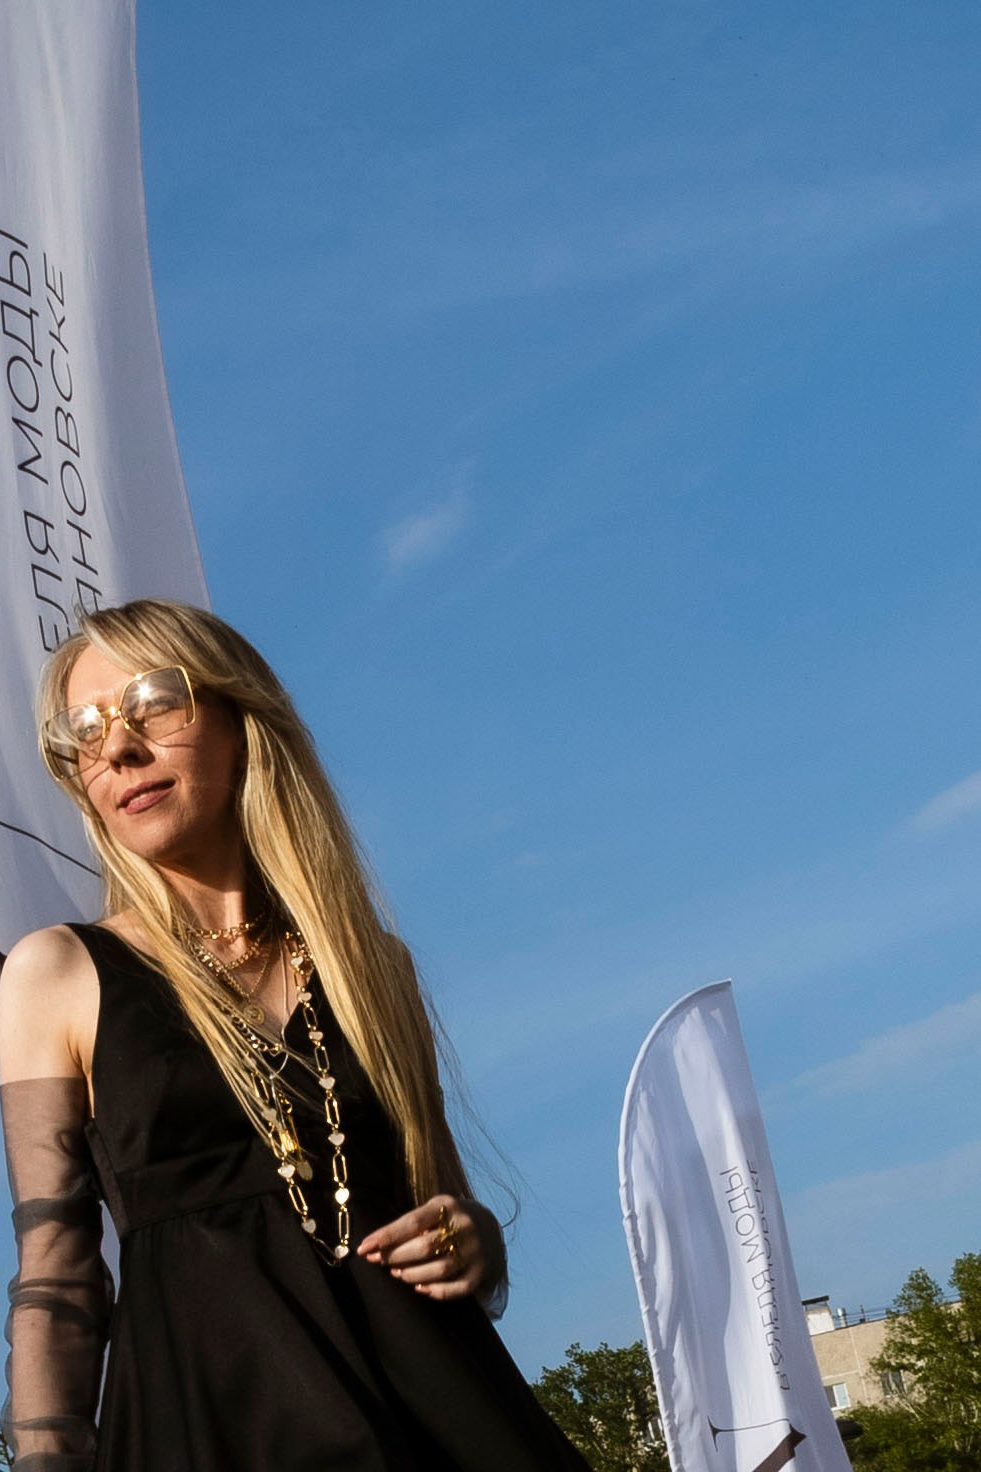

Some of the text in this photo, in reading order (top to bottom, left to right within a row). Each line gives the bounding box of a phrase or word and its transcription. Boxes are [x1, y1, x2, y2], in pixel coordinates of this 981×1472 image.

[42, 252, 103, 616] ЯНОВСКЕ
[23, 510, 70, 653] ЕЛЯ
[719, 1165, 765, 1263] МОДЫ
